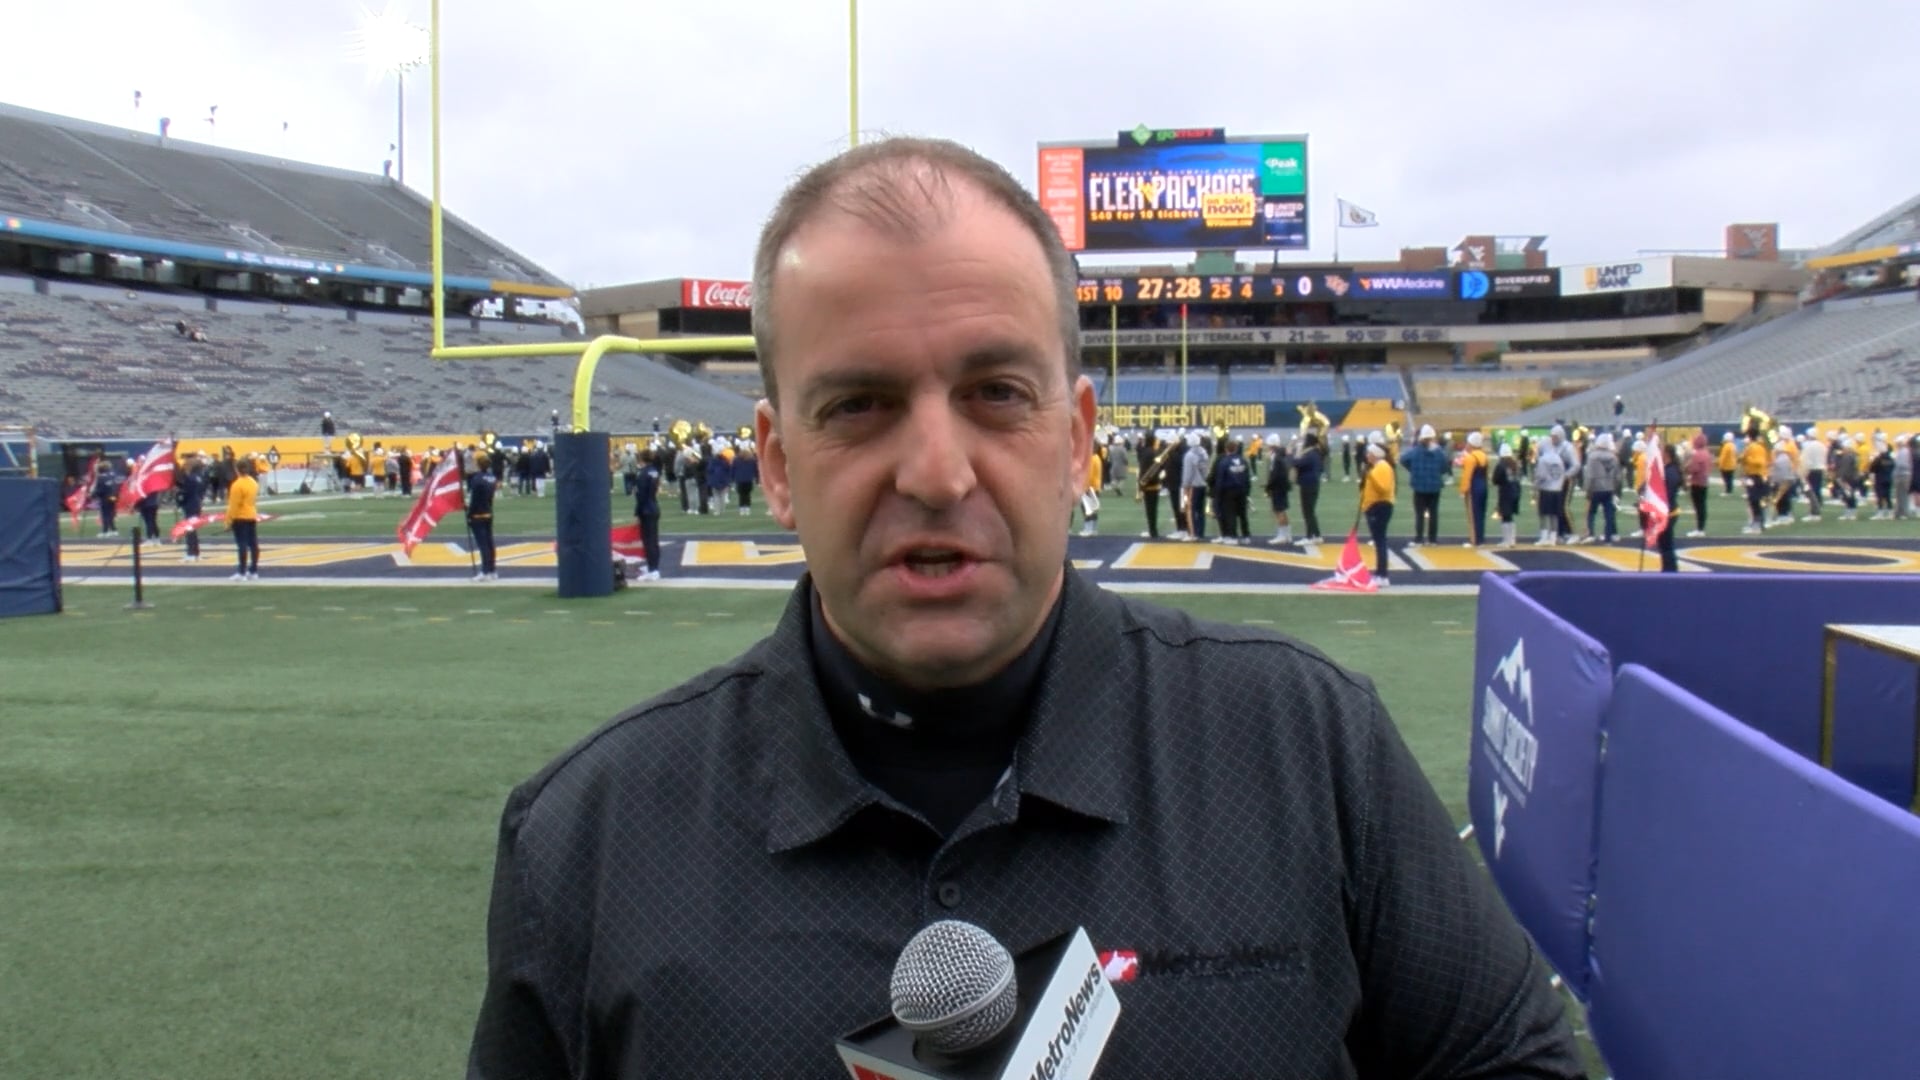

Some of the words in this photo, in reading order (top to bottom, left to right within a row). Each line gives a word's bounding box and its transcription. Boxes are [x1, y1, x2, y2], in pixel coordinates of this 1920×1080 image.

[1089, 176, 1145, 211] FLEX
[1116, 211, 1135, 220] for
[1140, 211, 1154, 220] 10
[1158, 209, 1199, 220] tickets
[1207, 202, 1251, 215] now!
[1597, 263, 1643, 277] UNITED
[1297, 276, 1312, 296] 0
[1495, 275, 1551, 285] DIVERSIFIED
[1598, 276, 1631, 289] BANK
[1076, 286, 1099, 301] 1ST
[1104, 286, 1123, 301] 10
[1137, 277, 1201, 299] 27:28
[1210, 283, 1233, 299] 25
[1240, 283, 1253, 299] 4
[1274, 284, 1284, 296] 3
[1084, 333, 1152, 345] DIVERSIFIED
[1155, 332, 1198, 344] ENERGY
[1200, 331, 1255, 343] TERRACE
[1288, 330, 1304, 342] 21
[1346, 329, 1365, 342] 90
[1401, 329, 1420, 341] 66
[1140, 405, 1158, 427] OF
[1160, 405, 1198, 427] WEST
[1200, 404, 1266, 427] VIRGINIA
